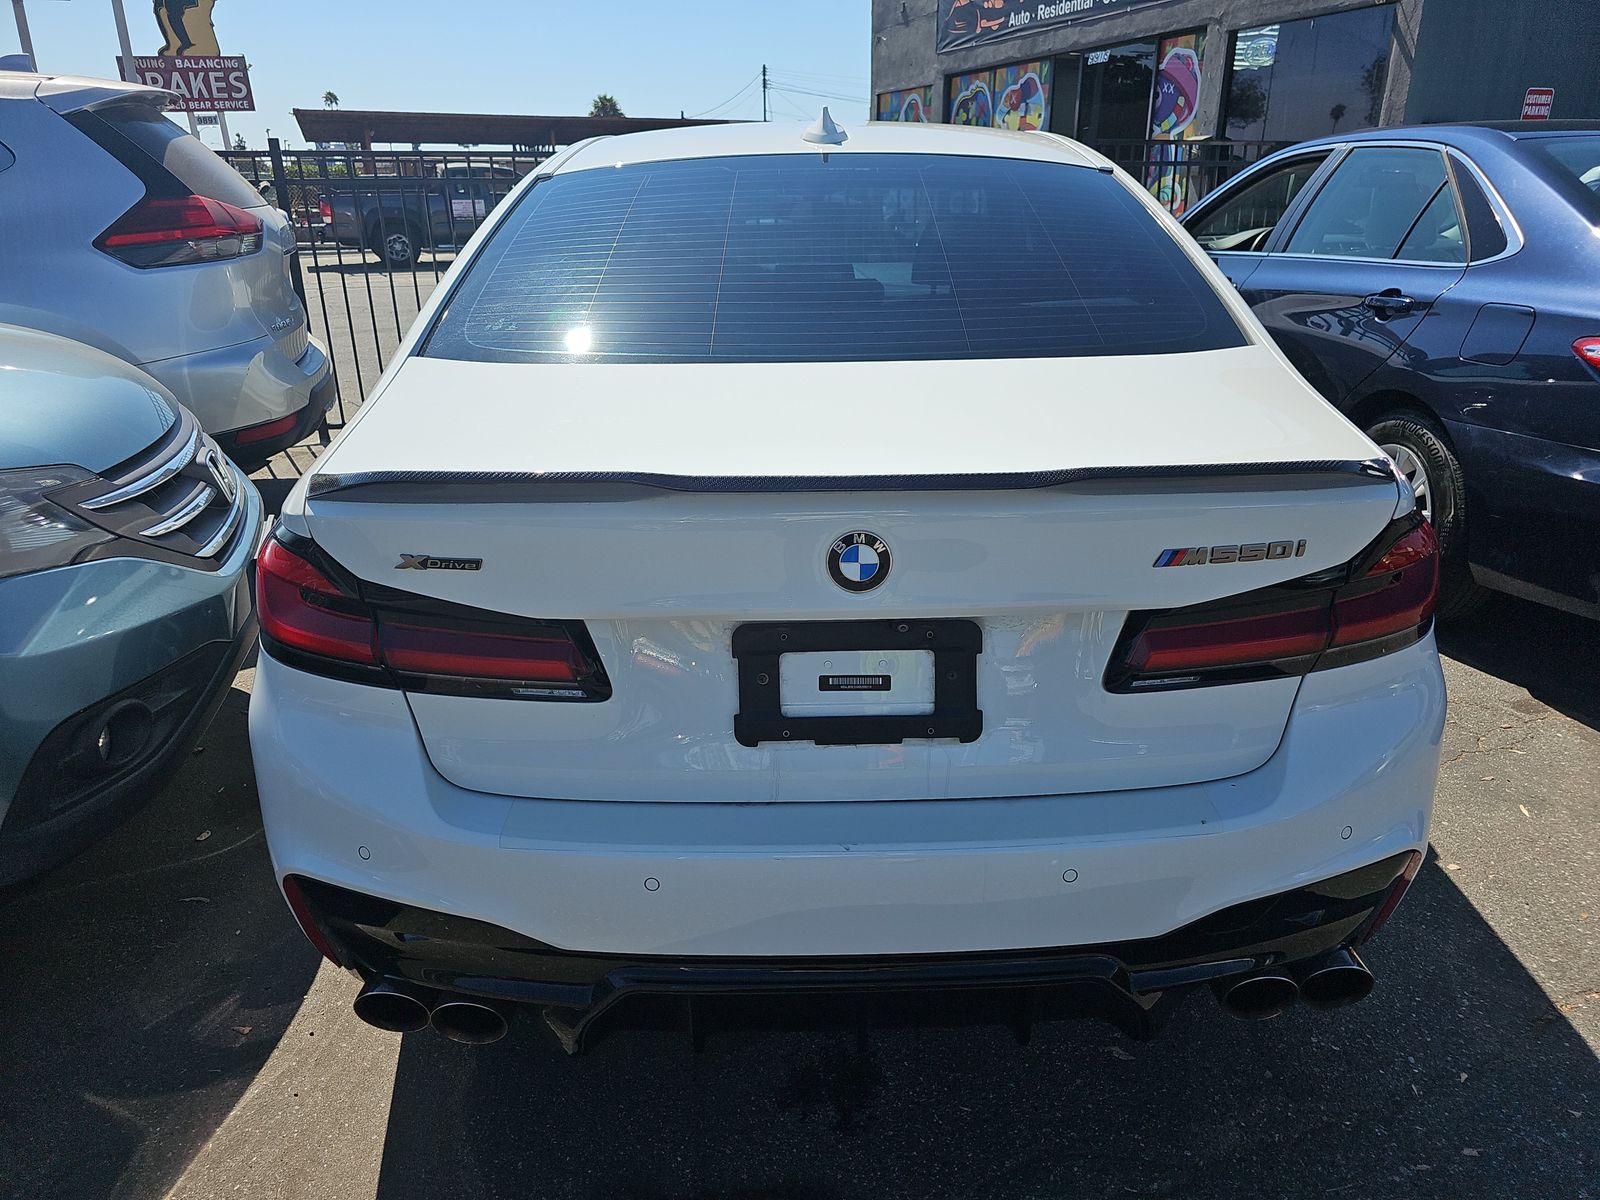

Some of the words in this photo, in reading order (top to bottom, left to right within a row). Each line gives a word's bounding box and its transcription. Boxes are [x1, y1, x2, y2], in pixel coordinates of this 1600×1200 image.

[1008, 12, 1030, 27] Auto
[135, 58, 166, 69] RUING
[175, 58, 239, 69] BALANCING
[138, 71, 248, 99] RAKES
[189, 101, 212, 110] BEAR
[214, 100, 249, 109] SERVICE
[1526, 94, 1552, 104] CUSTOMER
[1523, 105, 1550, 116] PARKING
[834, 533, 886, 554] BMW
[1177, 540, 1307, 566] M550i
